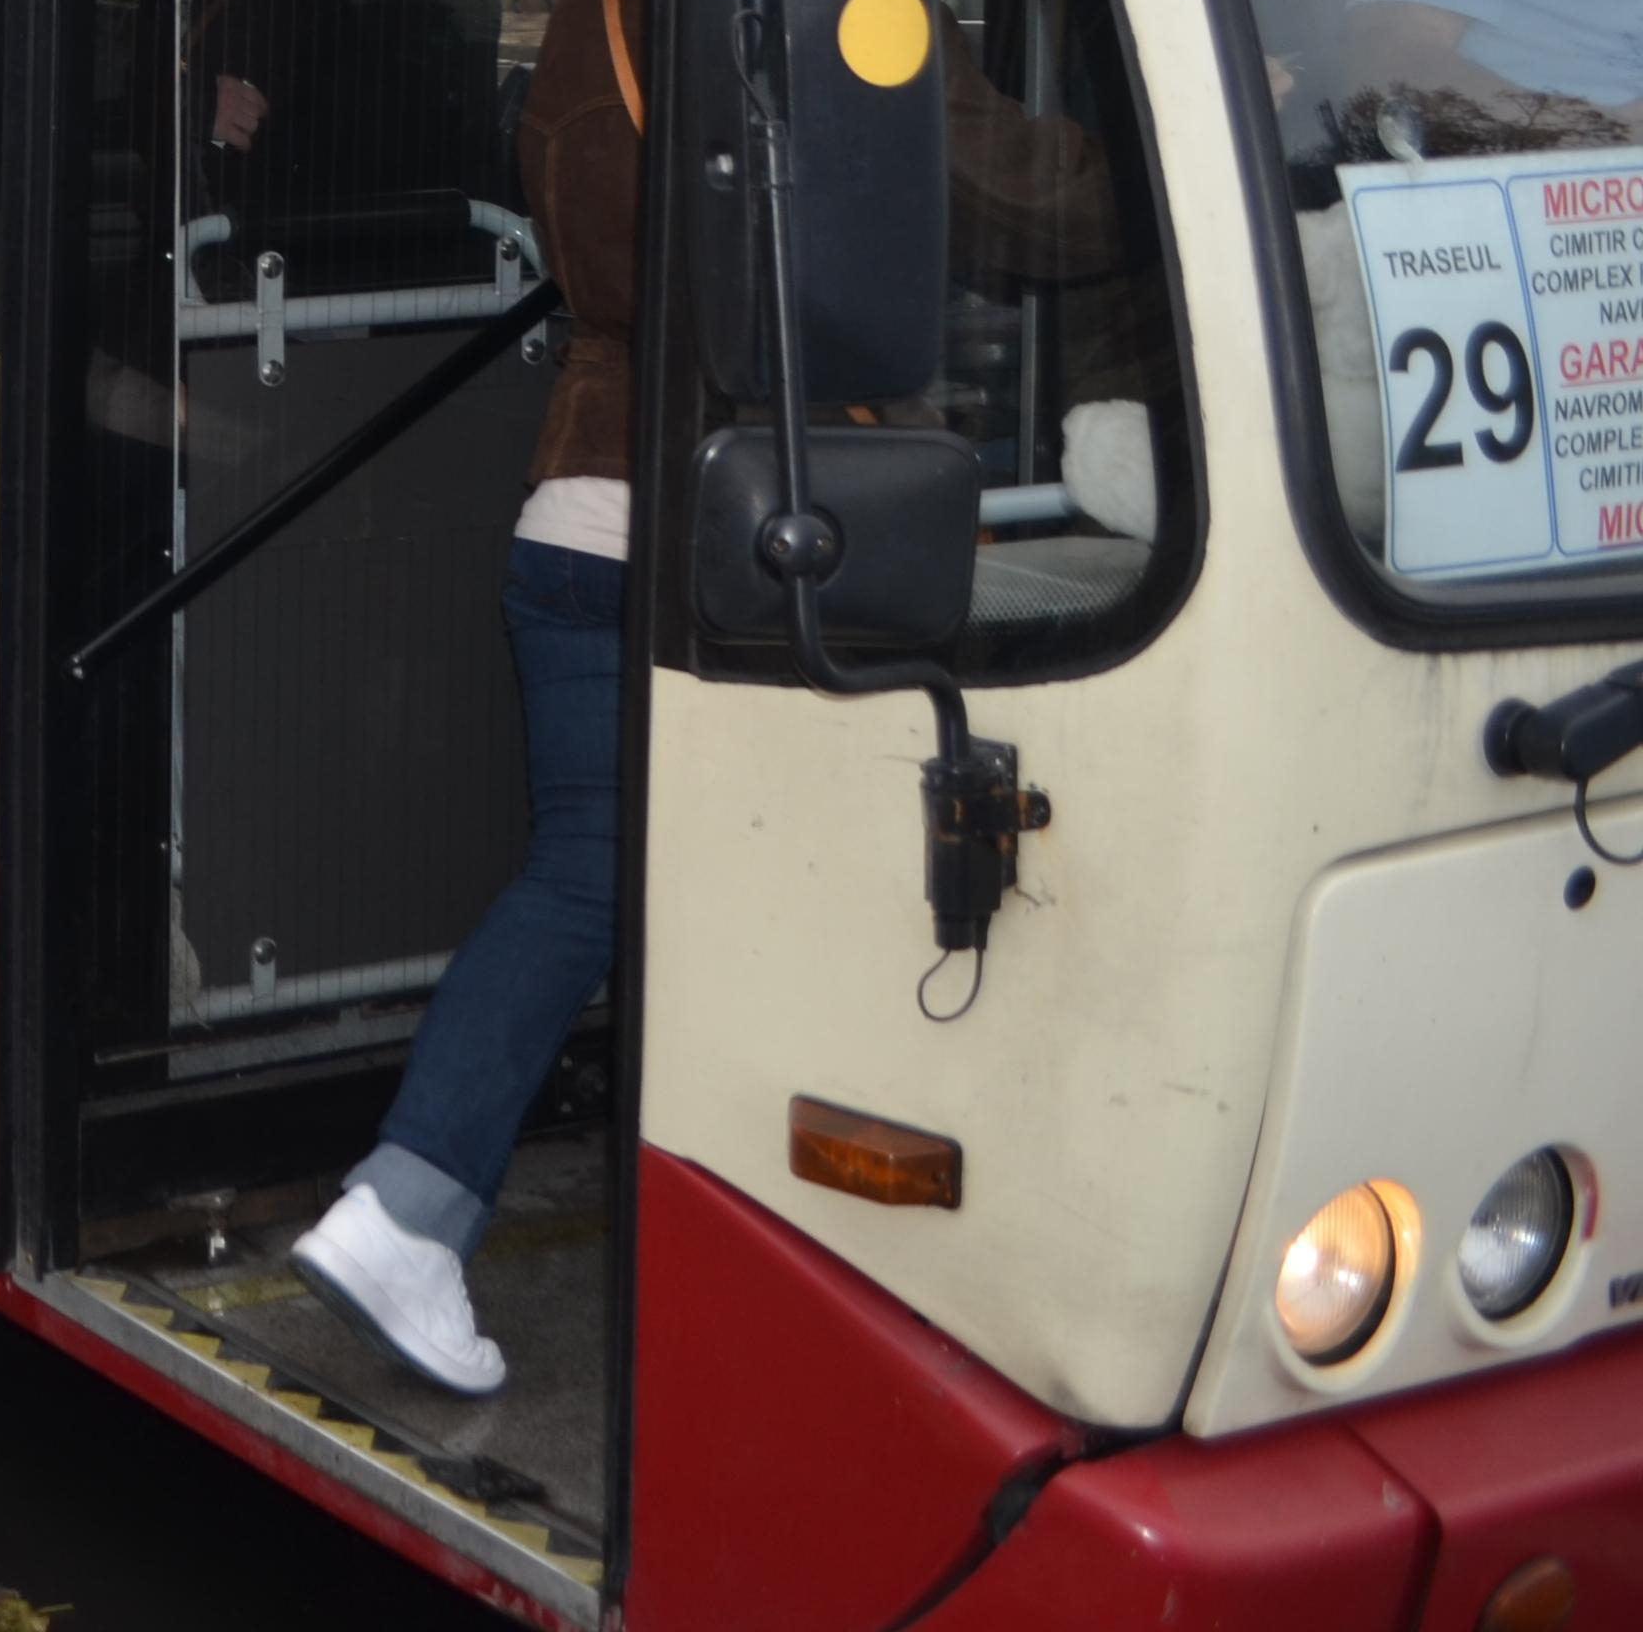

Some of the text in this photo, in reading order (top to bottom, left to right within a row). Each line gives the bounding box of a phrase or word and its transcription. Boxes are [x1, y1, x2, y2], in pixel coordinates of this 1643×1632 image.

[1550, 229, 1626, 258] CIMITIR
[1383, 244, 1502, 278] TRASEUL
[1531, 263, 1633, 295] COMPLEX
[1599, 297, 1643, 325] NAV
[1388, 320, 1535, 473] 29
